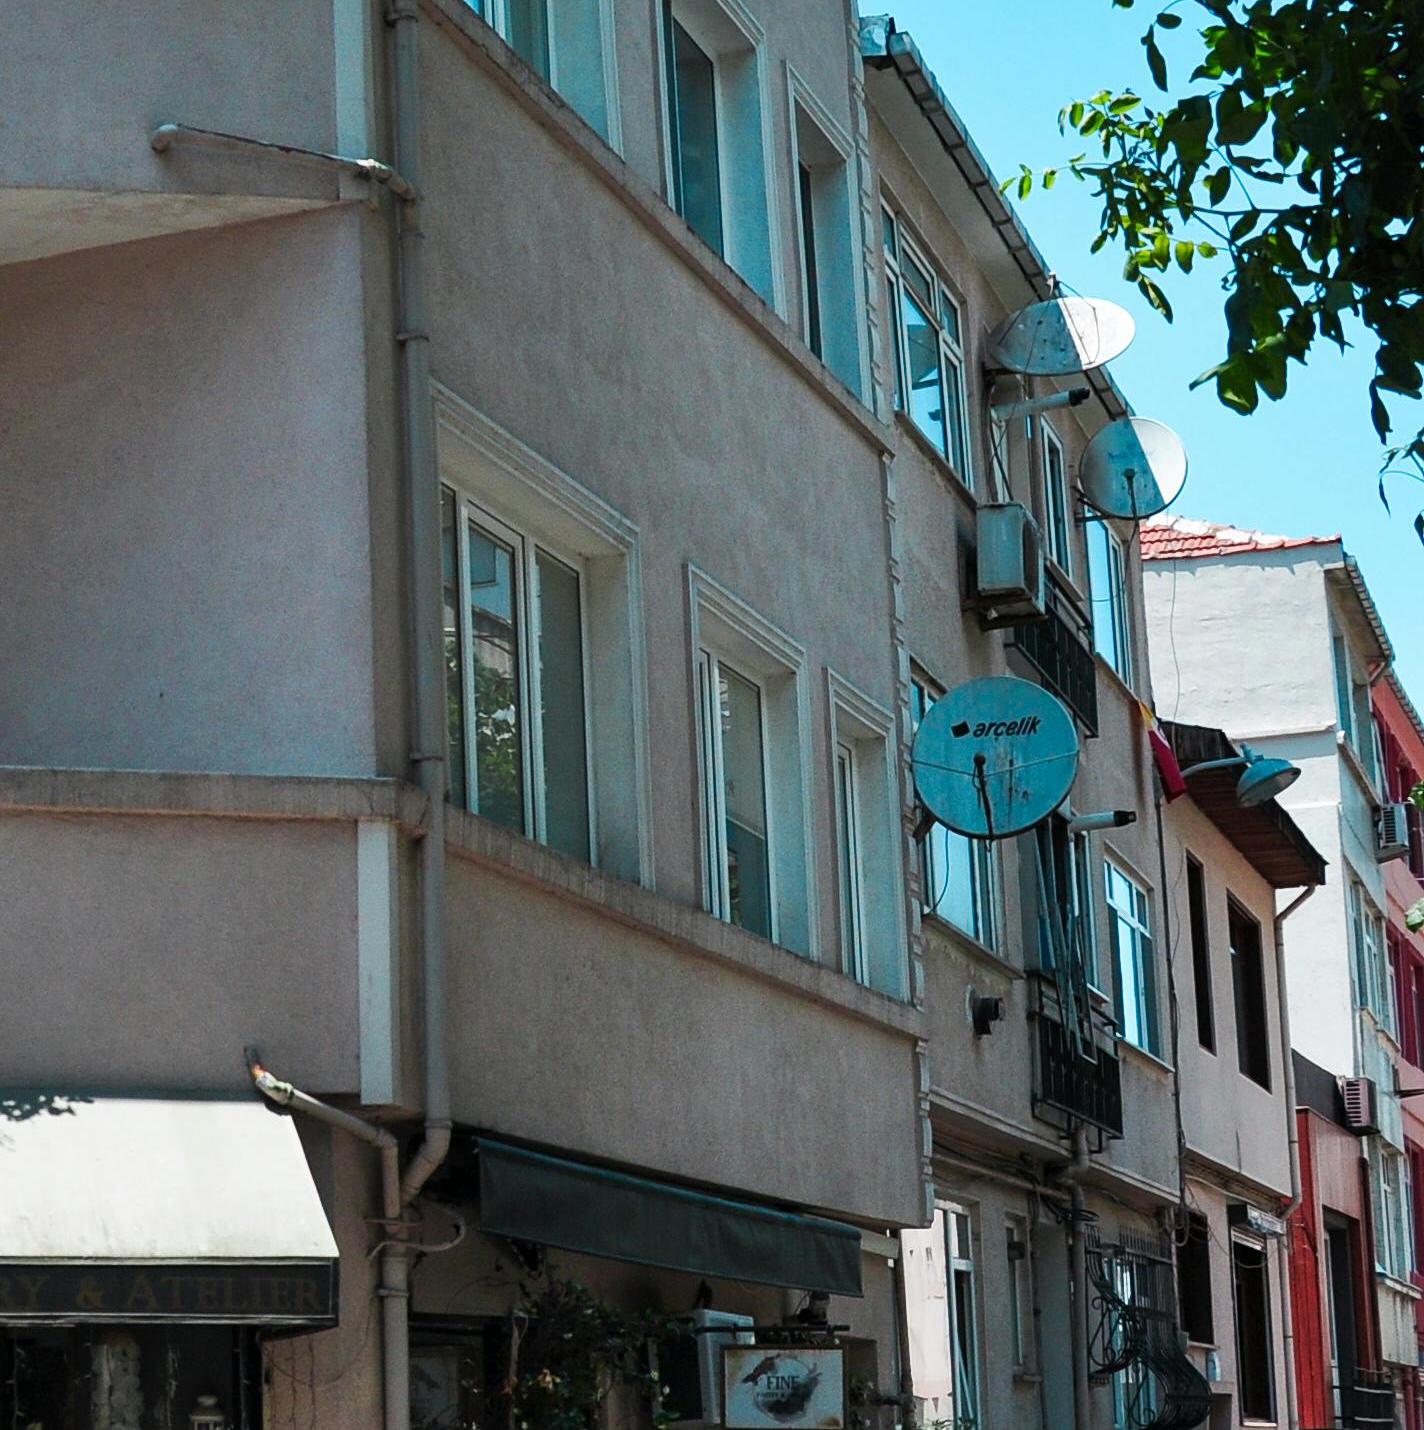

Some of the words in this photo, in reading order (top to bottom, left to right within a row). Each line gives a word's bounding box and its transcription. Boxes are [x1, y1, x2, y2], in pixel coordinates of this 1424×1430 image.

[973, 716, 1041, 741] arçelik
[76, 1274, 105, 1309] &
[125, 1270, 324, 1310] ATELIER
[767, 1376, 800, 1390] FINE
